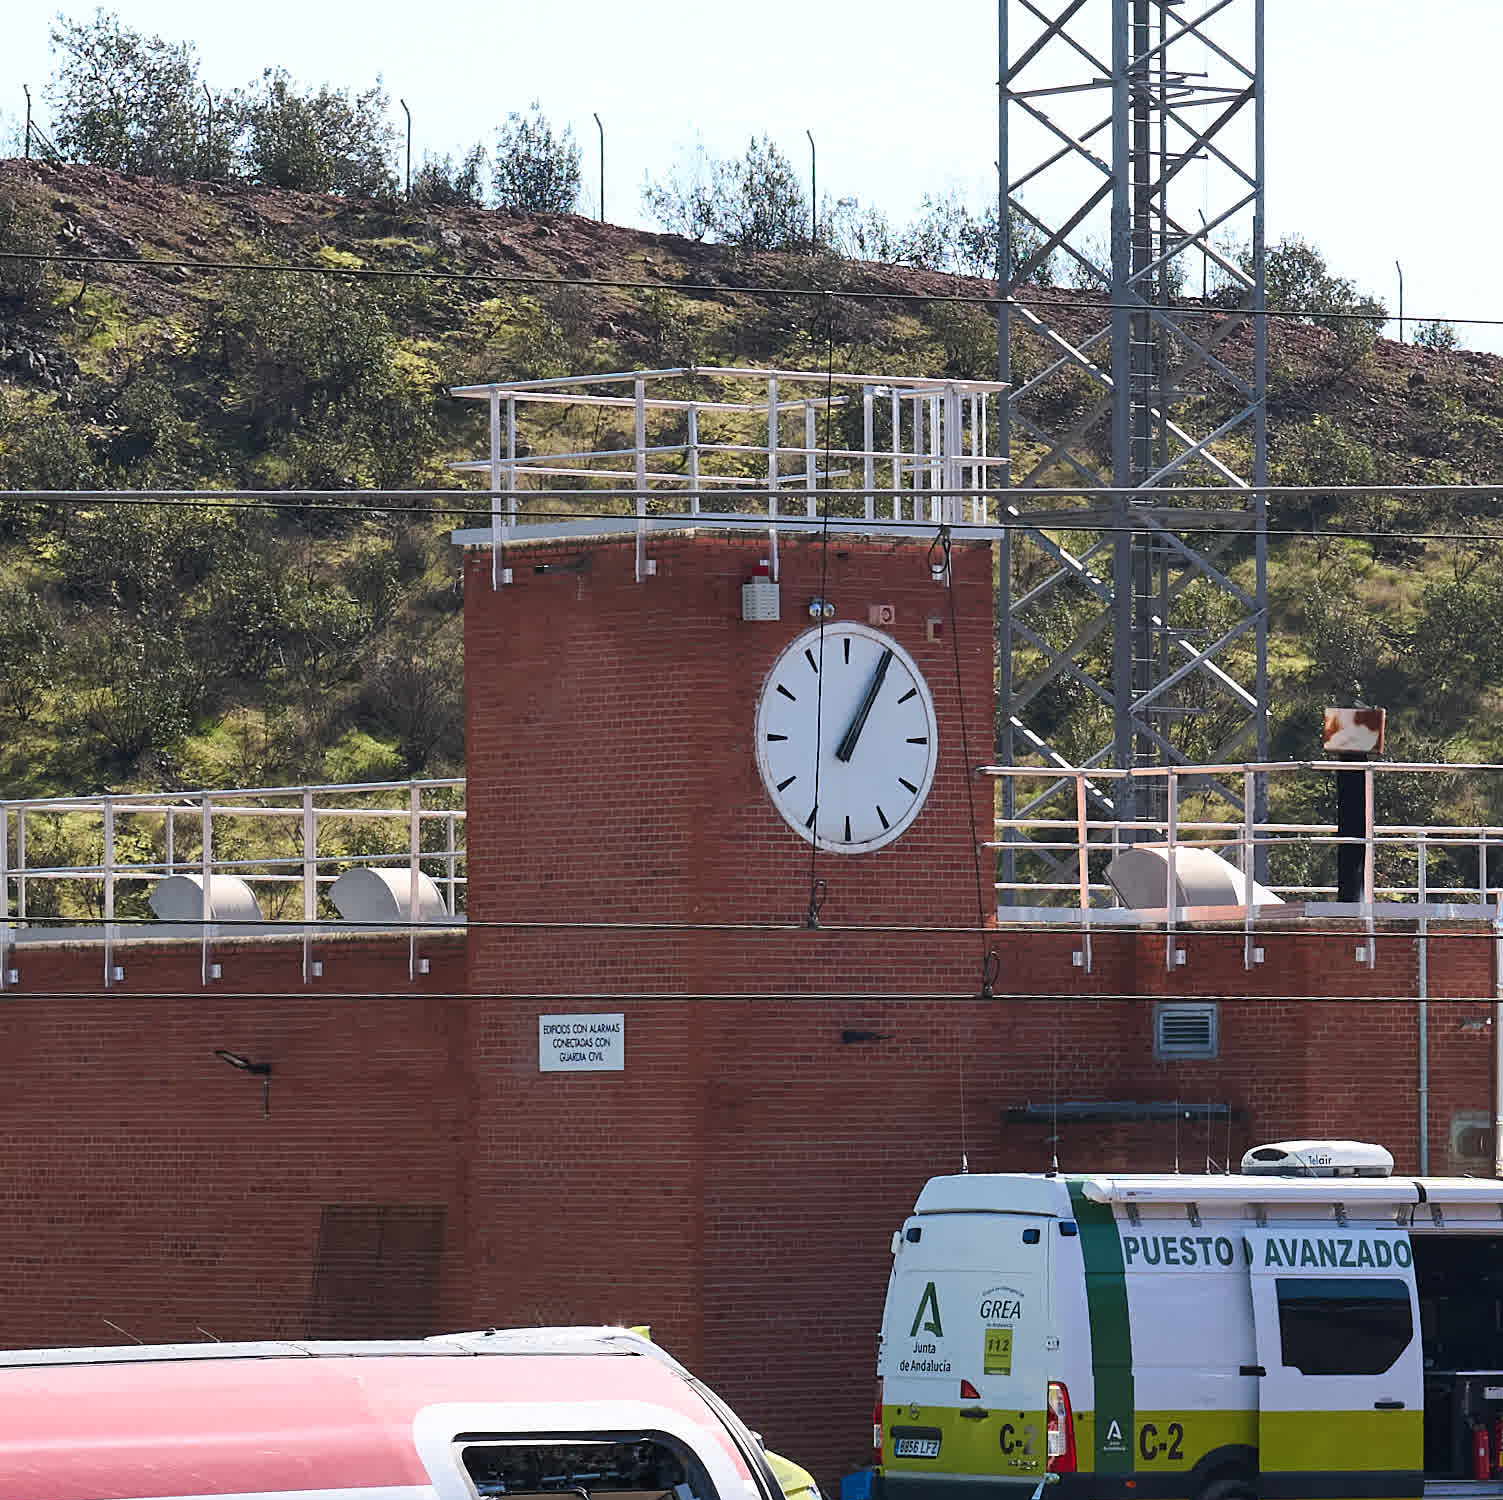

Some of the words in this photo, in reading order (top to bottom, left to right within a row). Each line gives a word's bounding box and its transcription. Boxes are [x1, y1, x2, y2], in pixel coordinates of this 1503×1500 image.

[543, 1024, 571, 1034] EDIFICIOS
[572, 1024, 588, 1033] CON
[589, 1023, 620, 1032] ALARMAS
[552, 1038, 593, 1048] CONECTADAS
[595, 1038, 611, 1047] CON
[560, 1052, 586, 1062] GUARDIA
[588, 1051, 604, 1061] CIVIL
[1308, 1154, 1332, 1166] Telair
[1123, 1236, 1234, 1266] PUESTO
[1264, 1239, 1412, 1268] AVANZADO
[980, 1300, 1021, 1319] GREA
[913, 1342, 936, 1354] Junta
[988, 1338, 1010, 1352] 112
[899, 1360, 910, 1372] de
[1000, 1423, 1037, 1455] C-2
[1139, 1422, 1184, 1461] C-2
